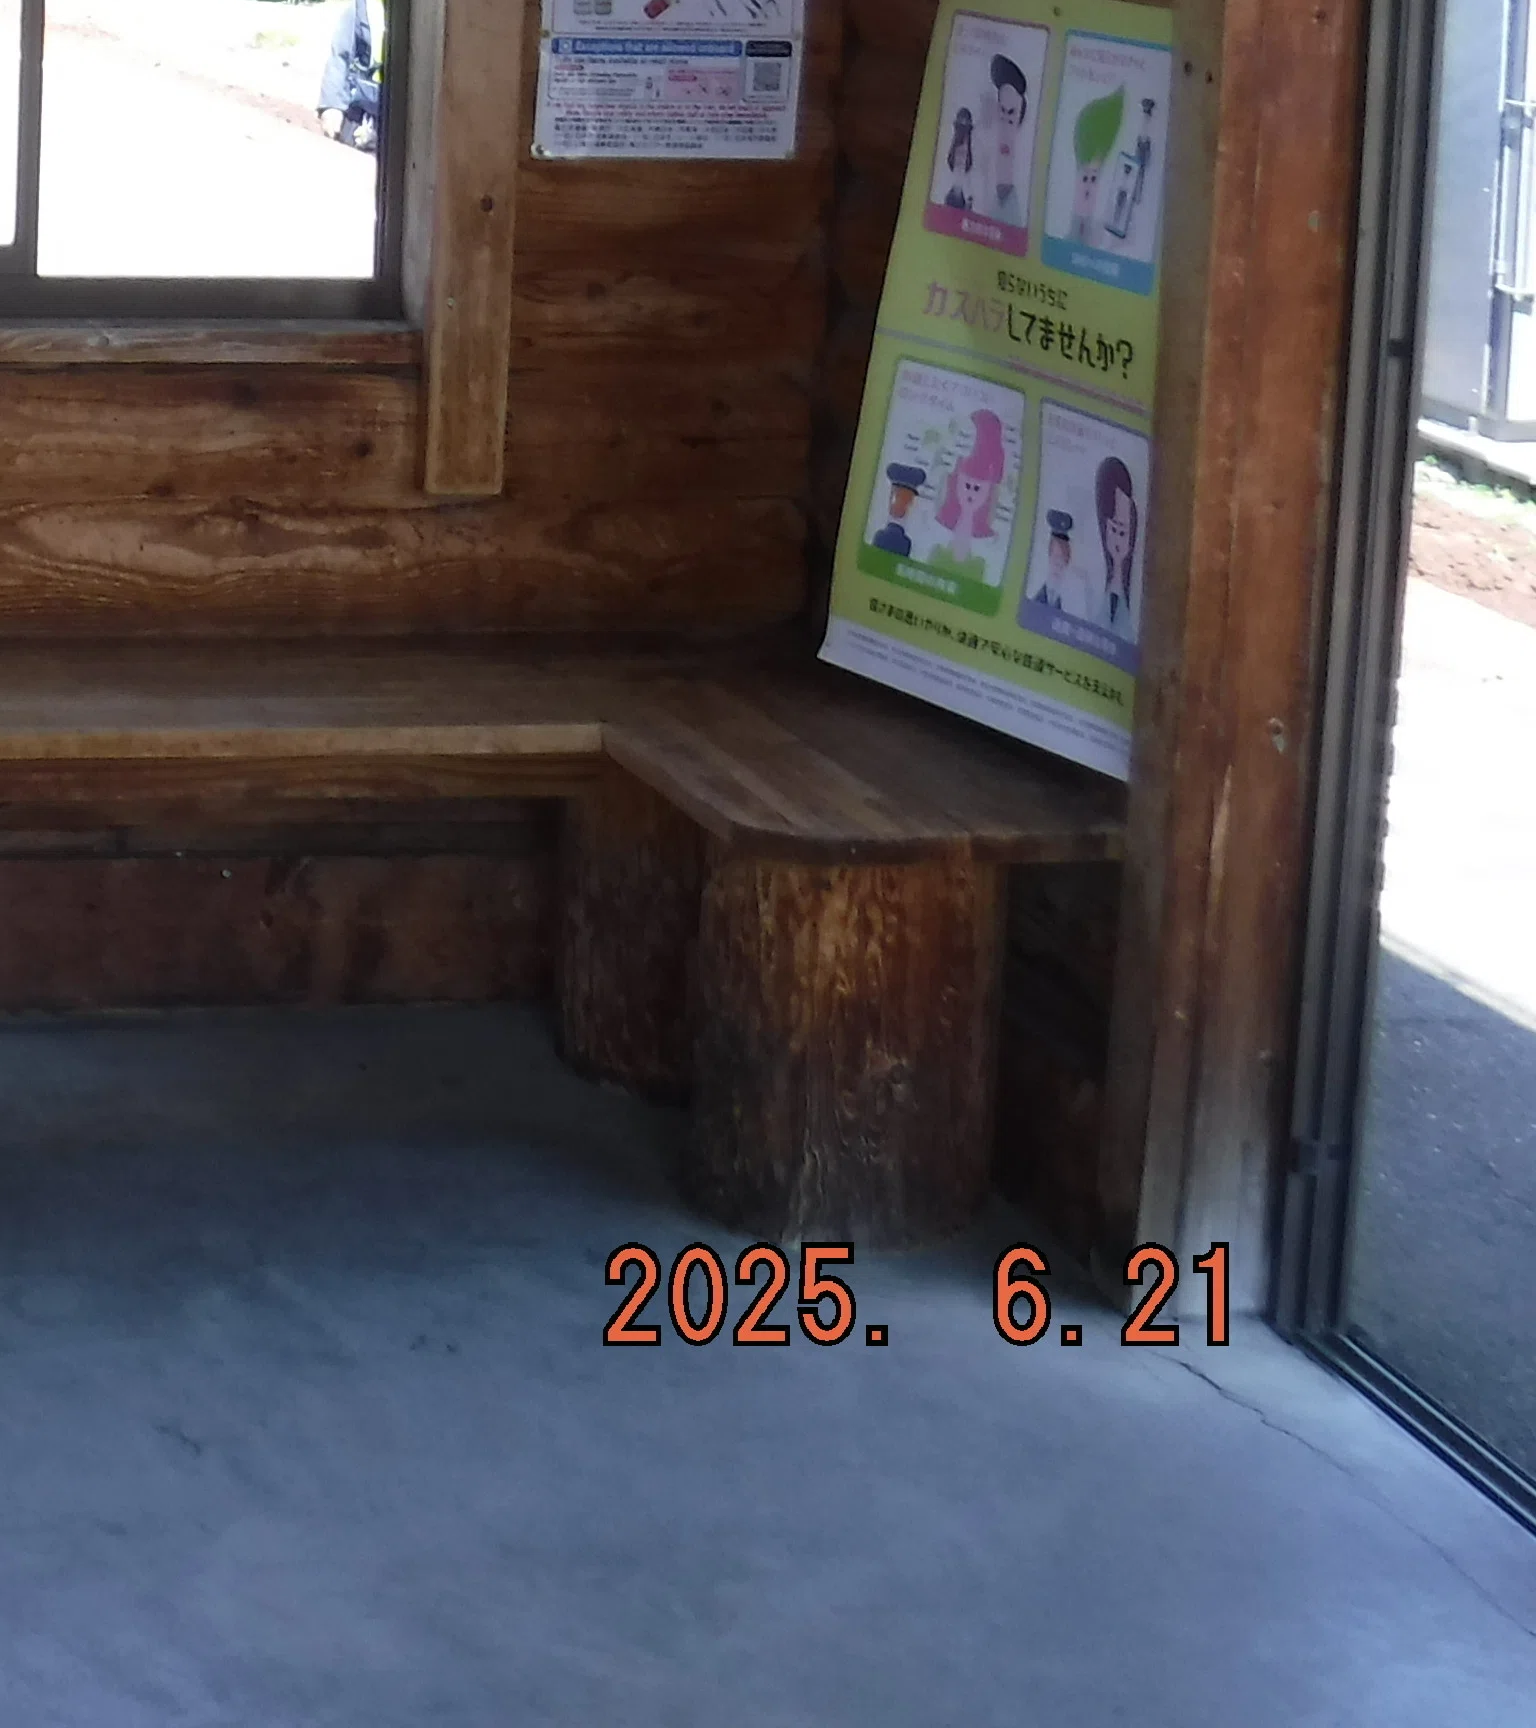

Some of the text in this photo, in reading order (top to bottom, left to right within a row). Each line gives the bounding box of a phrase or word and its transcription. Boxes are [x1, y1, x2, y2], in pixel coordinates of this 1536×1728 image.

[922, 279, 1135, 380] カスハラしてませんか?
